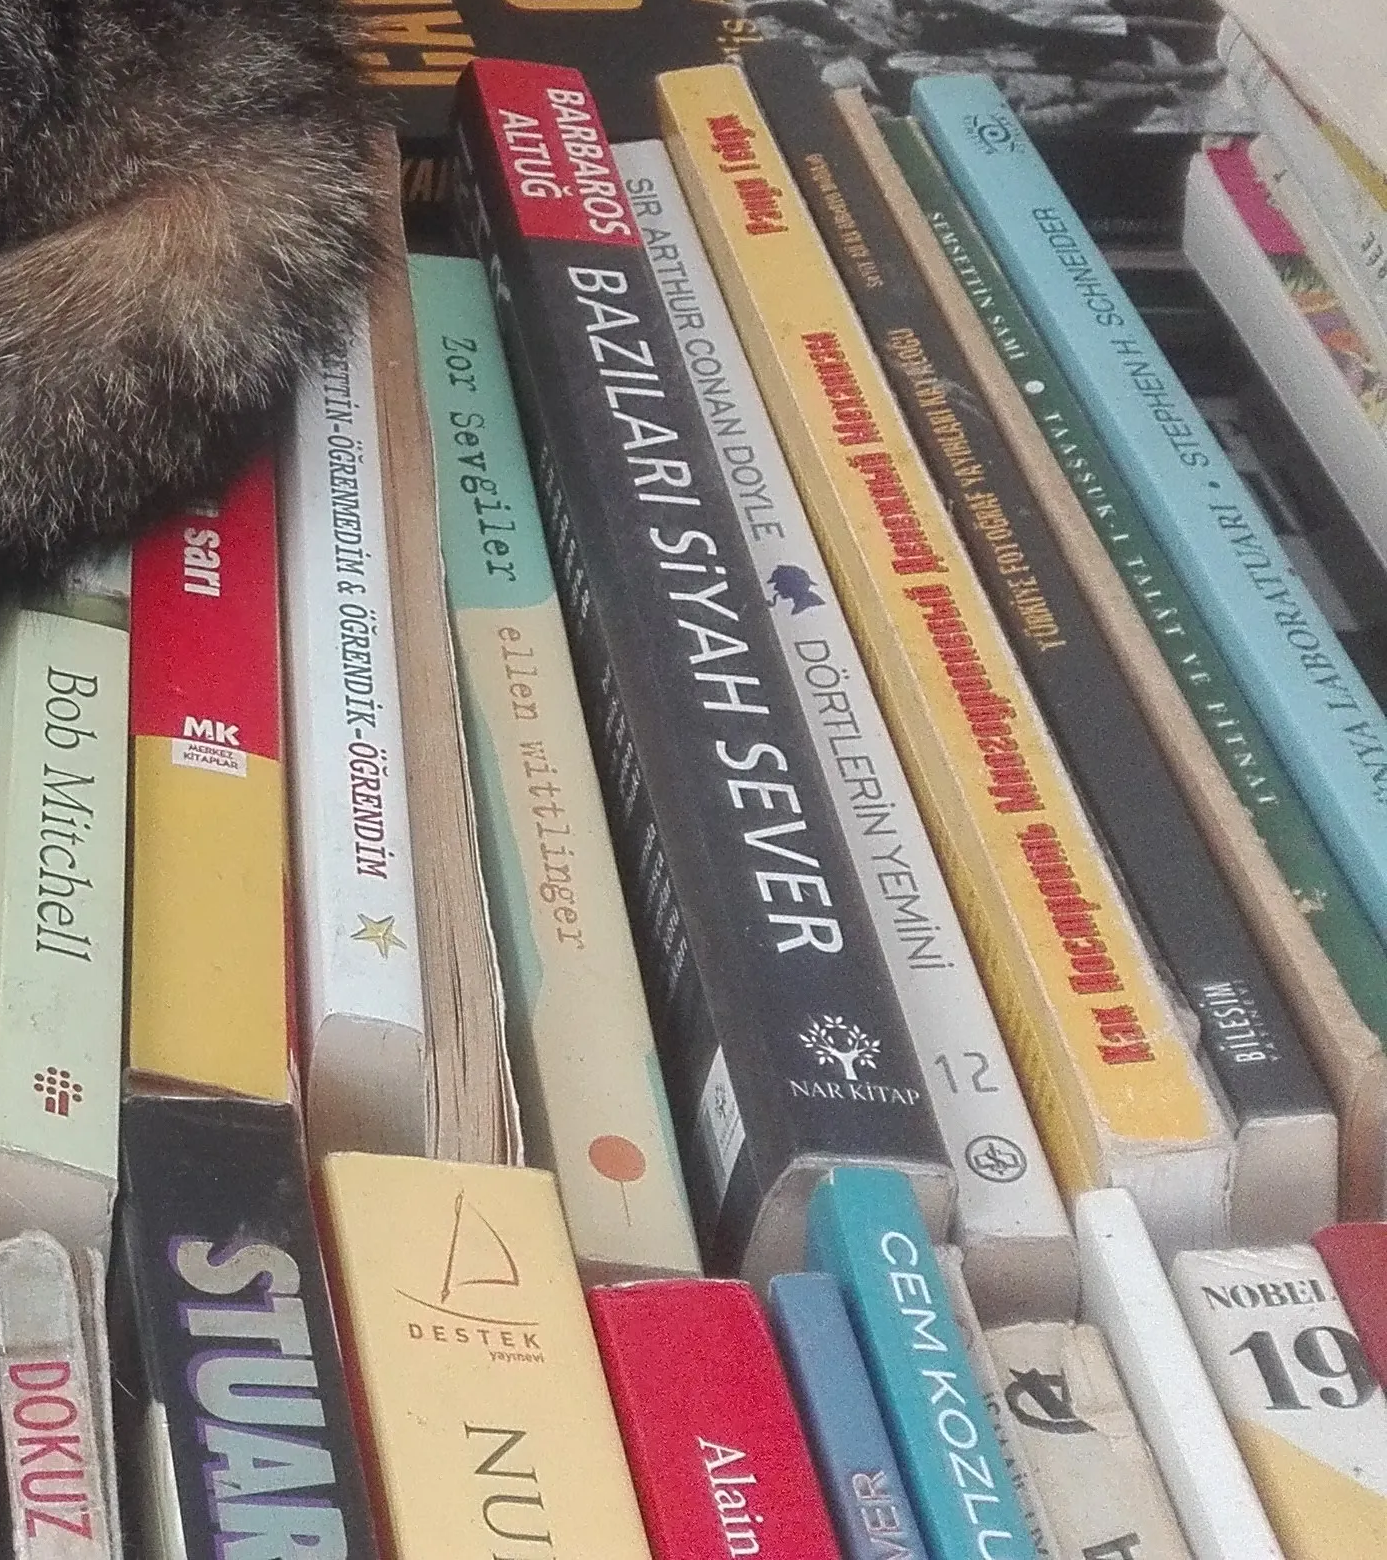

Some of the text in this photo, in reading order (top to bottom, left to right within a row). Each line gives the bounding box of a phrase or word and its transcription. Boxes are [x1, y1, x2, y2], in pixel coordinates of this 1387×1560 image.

[498, 108, 562, 198] ALTUĞ
[546, 86, 631, 240] BARBAROS
[1032, 206, 1126, 328] SCHNEIDER
[441, 335, 516, 583] Zor Sevgiler
[1127, 359, 1212, 470] STEPHEN
[965, 491, 1029, 578] FOTOĞRAF
[991, 312, 1027, 361] SAMİ
[1181, 656, 1213, 685] VE
[567, 263, 702, 508] BAZILARI
[714, 740, 845, 956] SEVER
[626, 177, 1000, 1095] SIR ARTHUR CONAN DOYLE DÖRTLERİN YEMİNİ 12
[182, 715, 241, 746] MK
[182, 750, 240, 771] KİTAPLAR
[187, 742, 236, 761] MERKEZ
[497, 625, 585, 952] ellen wittlinger
[33, 664, 101, 963] Bob Mitchell
[790, 1079, 921, 1107] NAR KİTAP
[407, 1321, 542, 1351] DESTEK
[880, 1229, 949, 1354] CEM
[8, 1359, 95, 1541] DOKUZ
[697, 1435, 764, 1559] Alain
